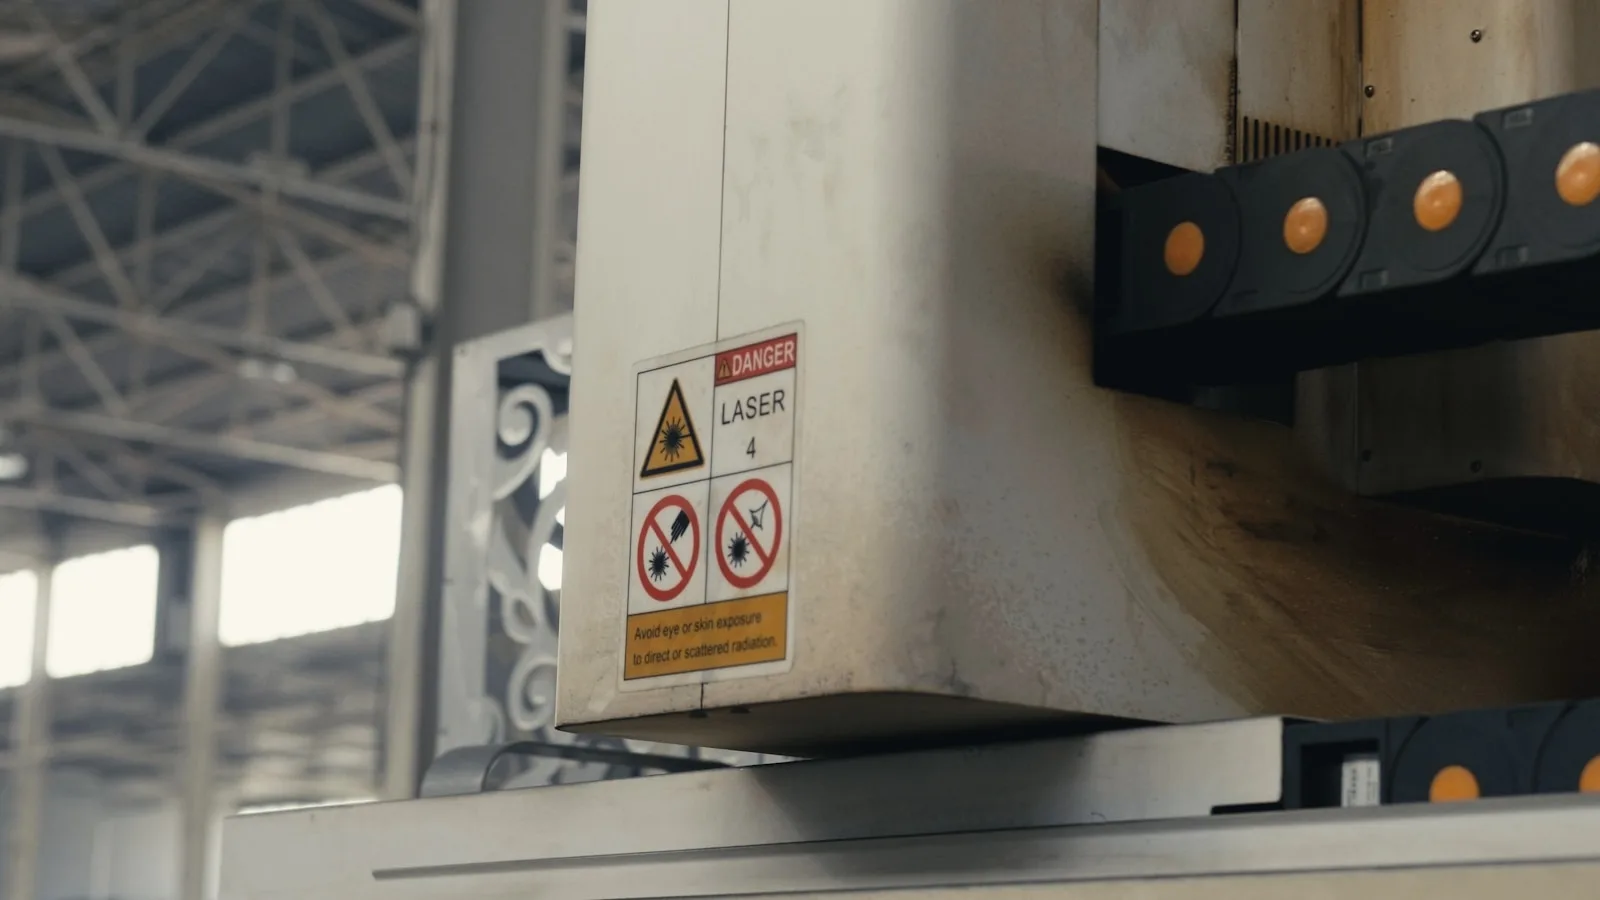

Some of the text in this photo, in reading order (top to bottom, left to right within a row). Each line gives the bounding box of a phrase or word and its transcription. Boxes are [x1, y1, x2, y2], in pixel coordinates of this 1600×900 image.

[732, 340, 795, 376] DANGER
[721, 389, 785, 425] LASER
[746, 436, 756, 459] 4
[634, 611, 762, 641] Avoid eye or skin exposure
[633, 634, 777, 666] to direct or scattered radiation.
